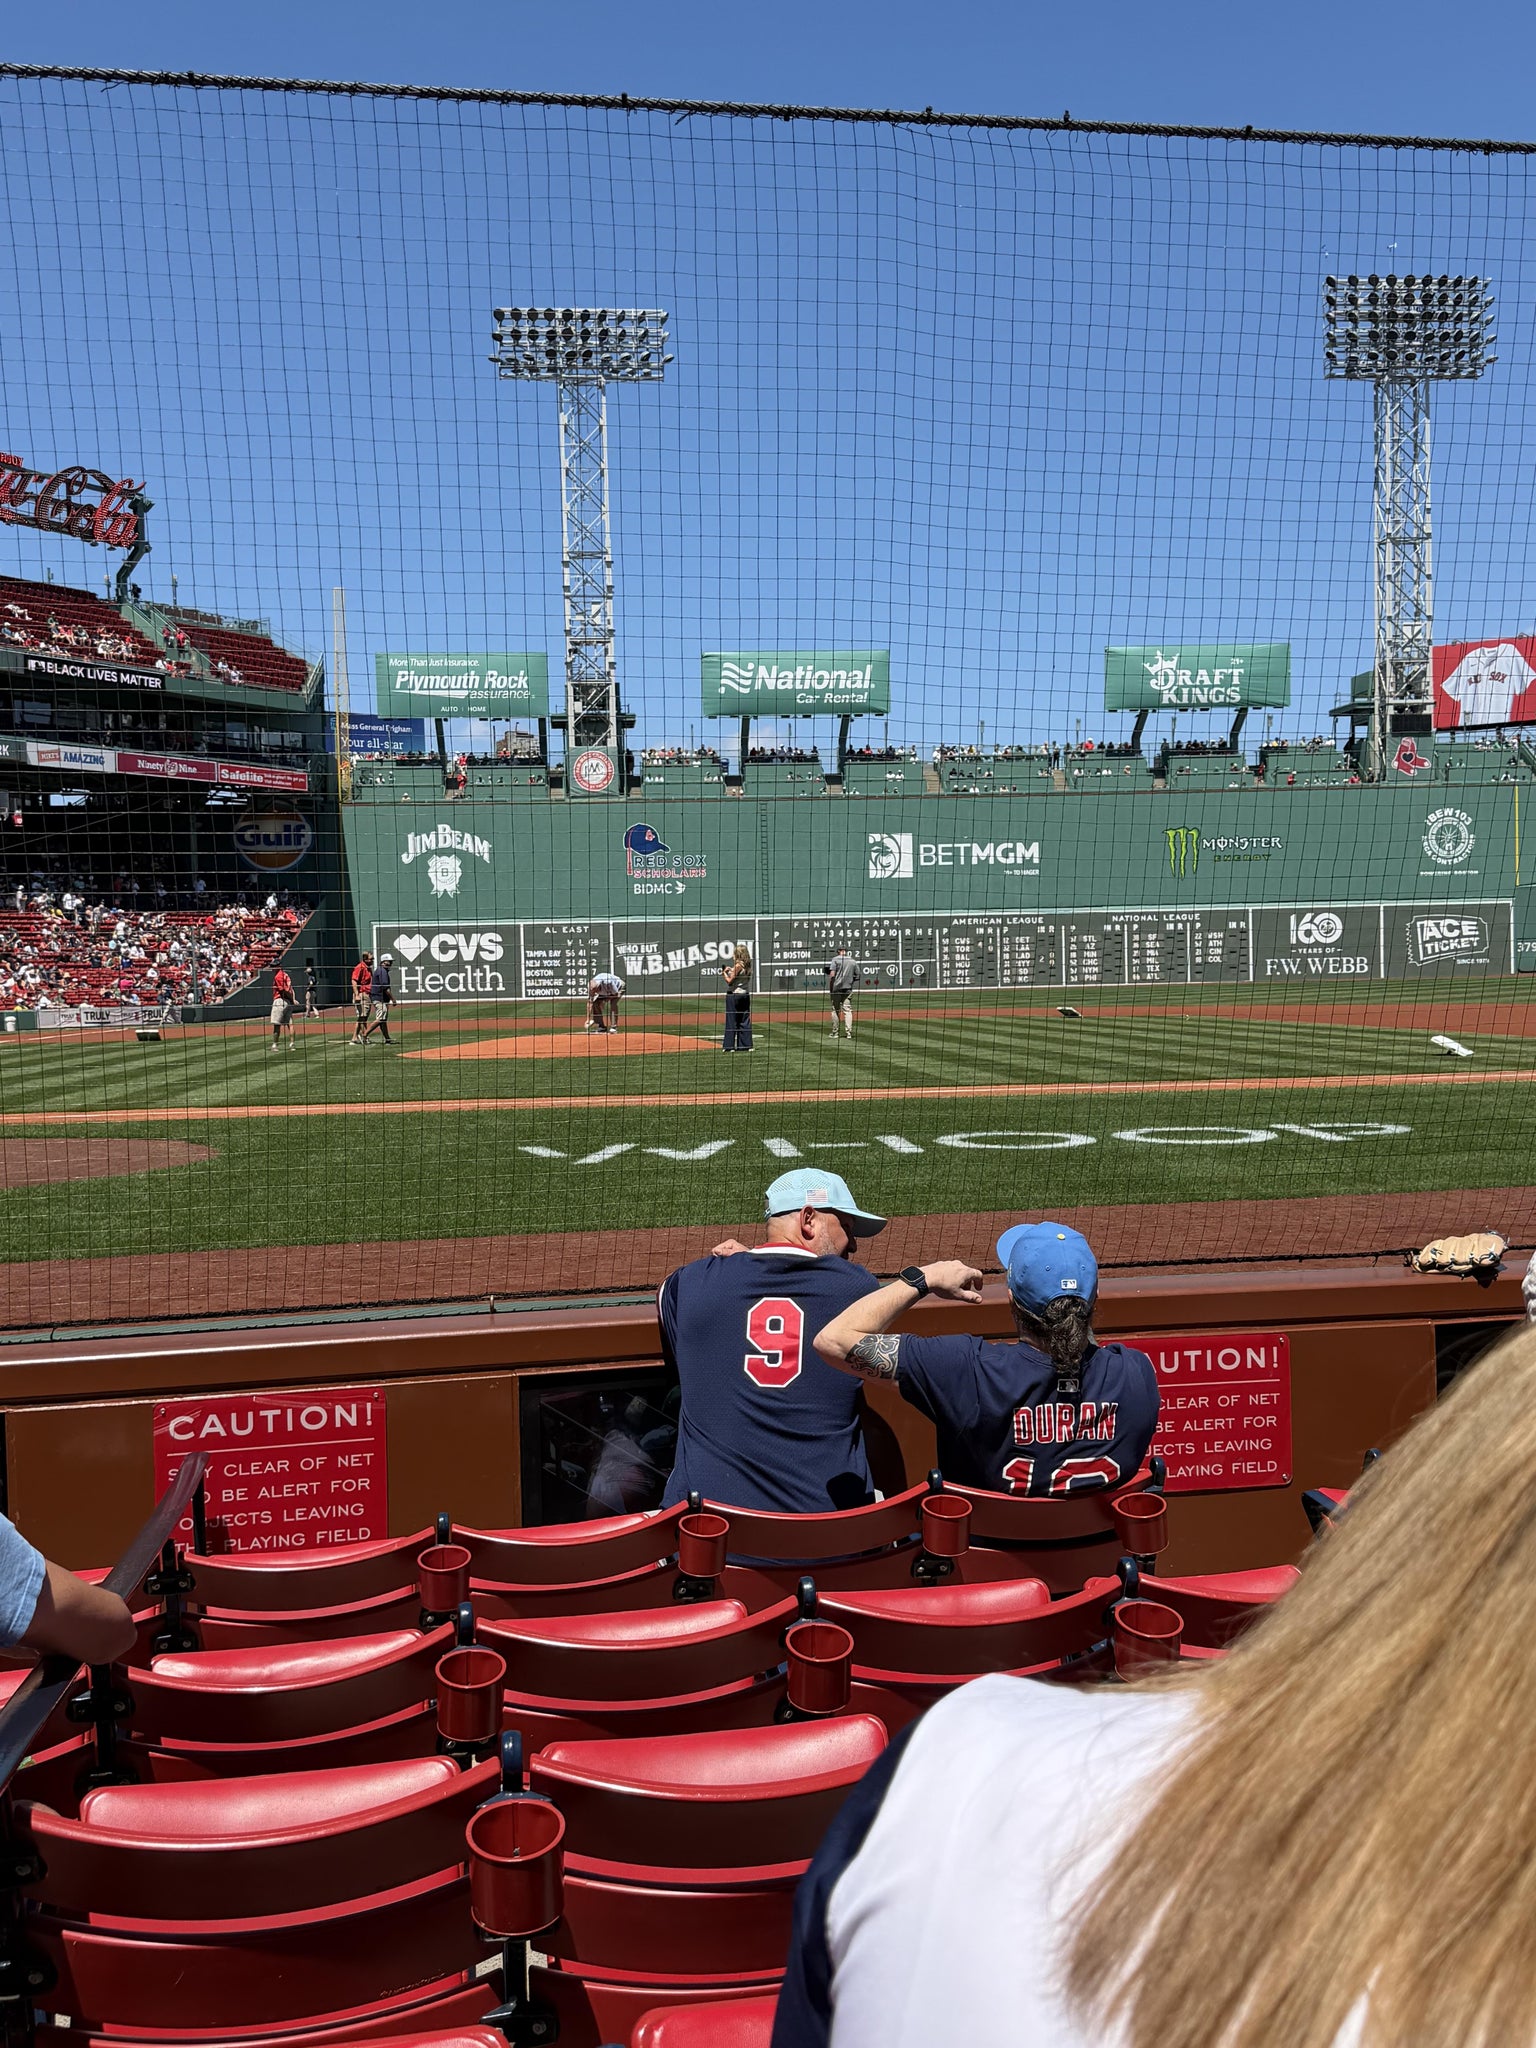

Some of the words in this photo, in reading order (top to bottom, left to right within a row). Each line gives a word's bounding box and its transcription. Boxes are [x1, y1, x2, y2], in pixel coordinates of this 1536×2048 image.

[389, 658, 408, 667] More
[410, 658, 428, 667] Than
[429, 658, 443, 667] Just
[46, 663, 85, 678] BLACK
[87, 668, 118, 683] LIVES
[120, 673, 162, 689] MATTER
[395, 670, 480, 692] Plymouth
[484, 670, 530, 689] Rock
[754, 665, 872, 691] National
[1150, 668, 1244, 691] DRAFT
[1489, 671, 1508, 683] SOX
[470, 689, 531, 699] assurance
[796, 692, 819, 704] Car
[824, 692, 868, 704] Rental
[1161, 686, 1241, 704] KINGS
[359, 723, 385, 731] General
[341, 737, 366, 748] Your
[63, 752, 105, 766] AMAZING
[137, 759, 164, 772] Ninety
[221, 769, 264, 783] Safelite
[1454, 809, 1473, 826] 103
[236, 824, 306, 846] Gulf
[401, 831, 436, 865] JIM
[437, 824, 491, 864] BEAM
[1202, 836, 1283, 851] MONSTER
[633, 855, 667, 867] RED
[672, 854, 707, 867] SOX
[919, 841, 1040, 866] BETMGM
[633, 867, 707, 879] SCHOLARS
[633, 883, 673, 895] BIDMC
[793, 920, 852, 928] FENWAY
[863, 919, 901, 927] PARK
[952, 917, 1002, 925] AMERICAN
[1112, 914, 1159, 922] NATIONAL
[1163, 913, 1201, 921] LEAGUE
[562, 926, 589, 934] EAST
[889, 929, 897, 937] 10
[1290, 912, 1344, 944] 160
[1423, 918, 1480, 941] ACE
[792, 940, 803, 948] TB
[1082, 935, 1097, 943] STL
[1424, 937, 1480, 954] TICKET
[429, 932, 504, 962] CVS
[525, 950, 547, 958] TAMPA
[578, 949, 586, 957] 41
[616, 944, 639, 955] WHO
[640, 943, 659, 953] BUT
[955, 945, 970, 953] TOR
[1209, 947, 1222, 955] CIN
[783, 951, 811, 960] BOSTON
[1208, 955, 1223, 963] COL
[525, 969, 554, 977] BOSTON
[774, 968, 784, 977] AT
[804, 967, 824, 976] BALL
[862, 967, 880, 975] OUT
[1265, 958, 1302, 976] F.W.
[1307, 956, 1369, 974] WEBB
[399, 964, 506, 993] Health
[525, 978, 563, 987] BALTIMORE
[526, 988, 560, 997] TORONTO
[578, 987, 588, 995] 52
[84, 1010, 111, 1021] TRULY
[142, 1009, 164, 1021] TRUL
[744, 1297, 804, 1388] 9
[1144, 1346, 1278, 1374] UTION!
[1217, 1395, 1241, 1407] OF
[1249, 1393, 1280, 1406] NET
[168, 1402, 373, 1441] CAUTION!
[1013, 1402, 1118, 1445] DURAN
[1183, 1418, 1235, 1432] ALERT
[1243, 1416, 1277, 1429] FOR
[1145, 1443, 1195, 1457] JECTS
[1204, 1439, 1272, 1453] LEAVING
[167, 1465, 213, 1482] SY
[223, 1459, 289, 1478] CLEAR
[300, 1457, 327, 1471] OF
[337, 1453, 374, 1468] NET
[1167, 1464, 1223, 1478] LAYING
[1232, 1461, 1278, 1474] FIELD
[222, 1488, 248, 1503] BE
[257, 1482, 320, 1500] ALERT
[330, 1478, 371, 1493] FOR
[179, 1511, 272, 1531] OJECTS
[283, 1503, 364, 1522] LEAVING
[224, 1533, 305, 1552] PLAYING
[316, 1527, 371, 1544] FIELD
